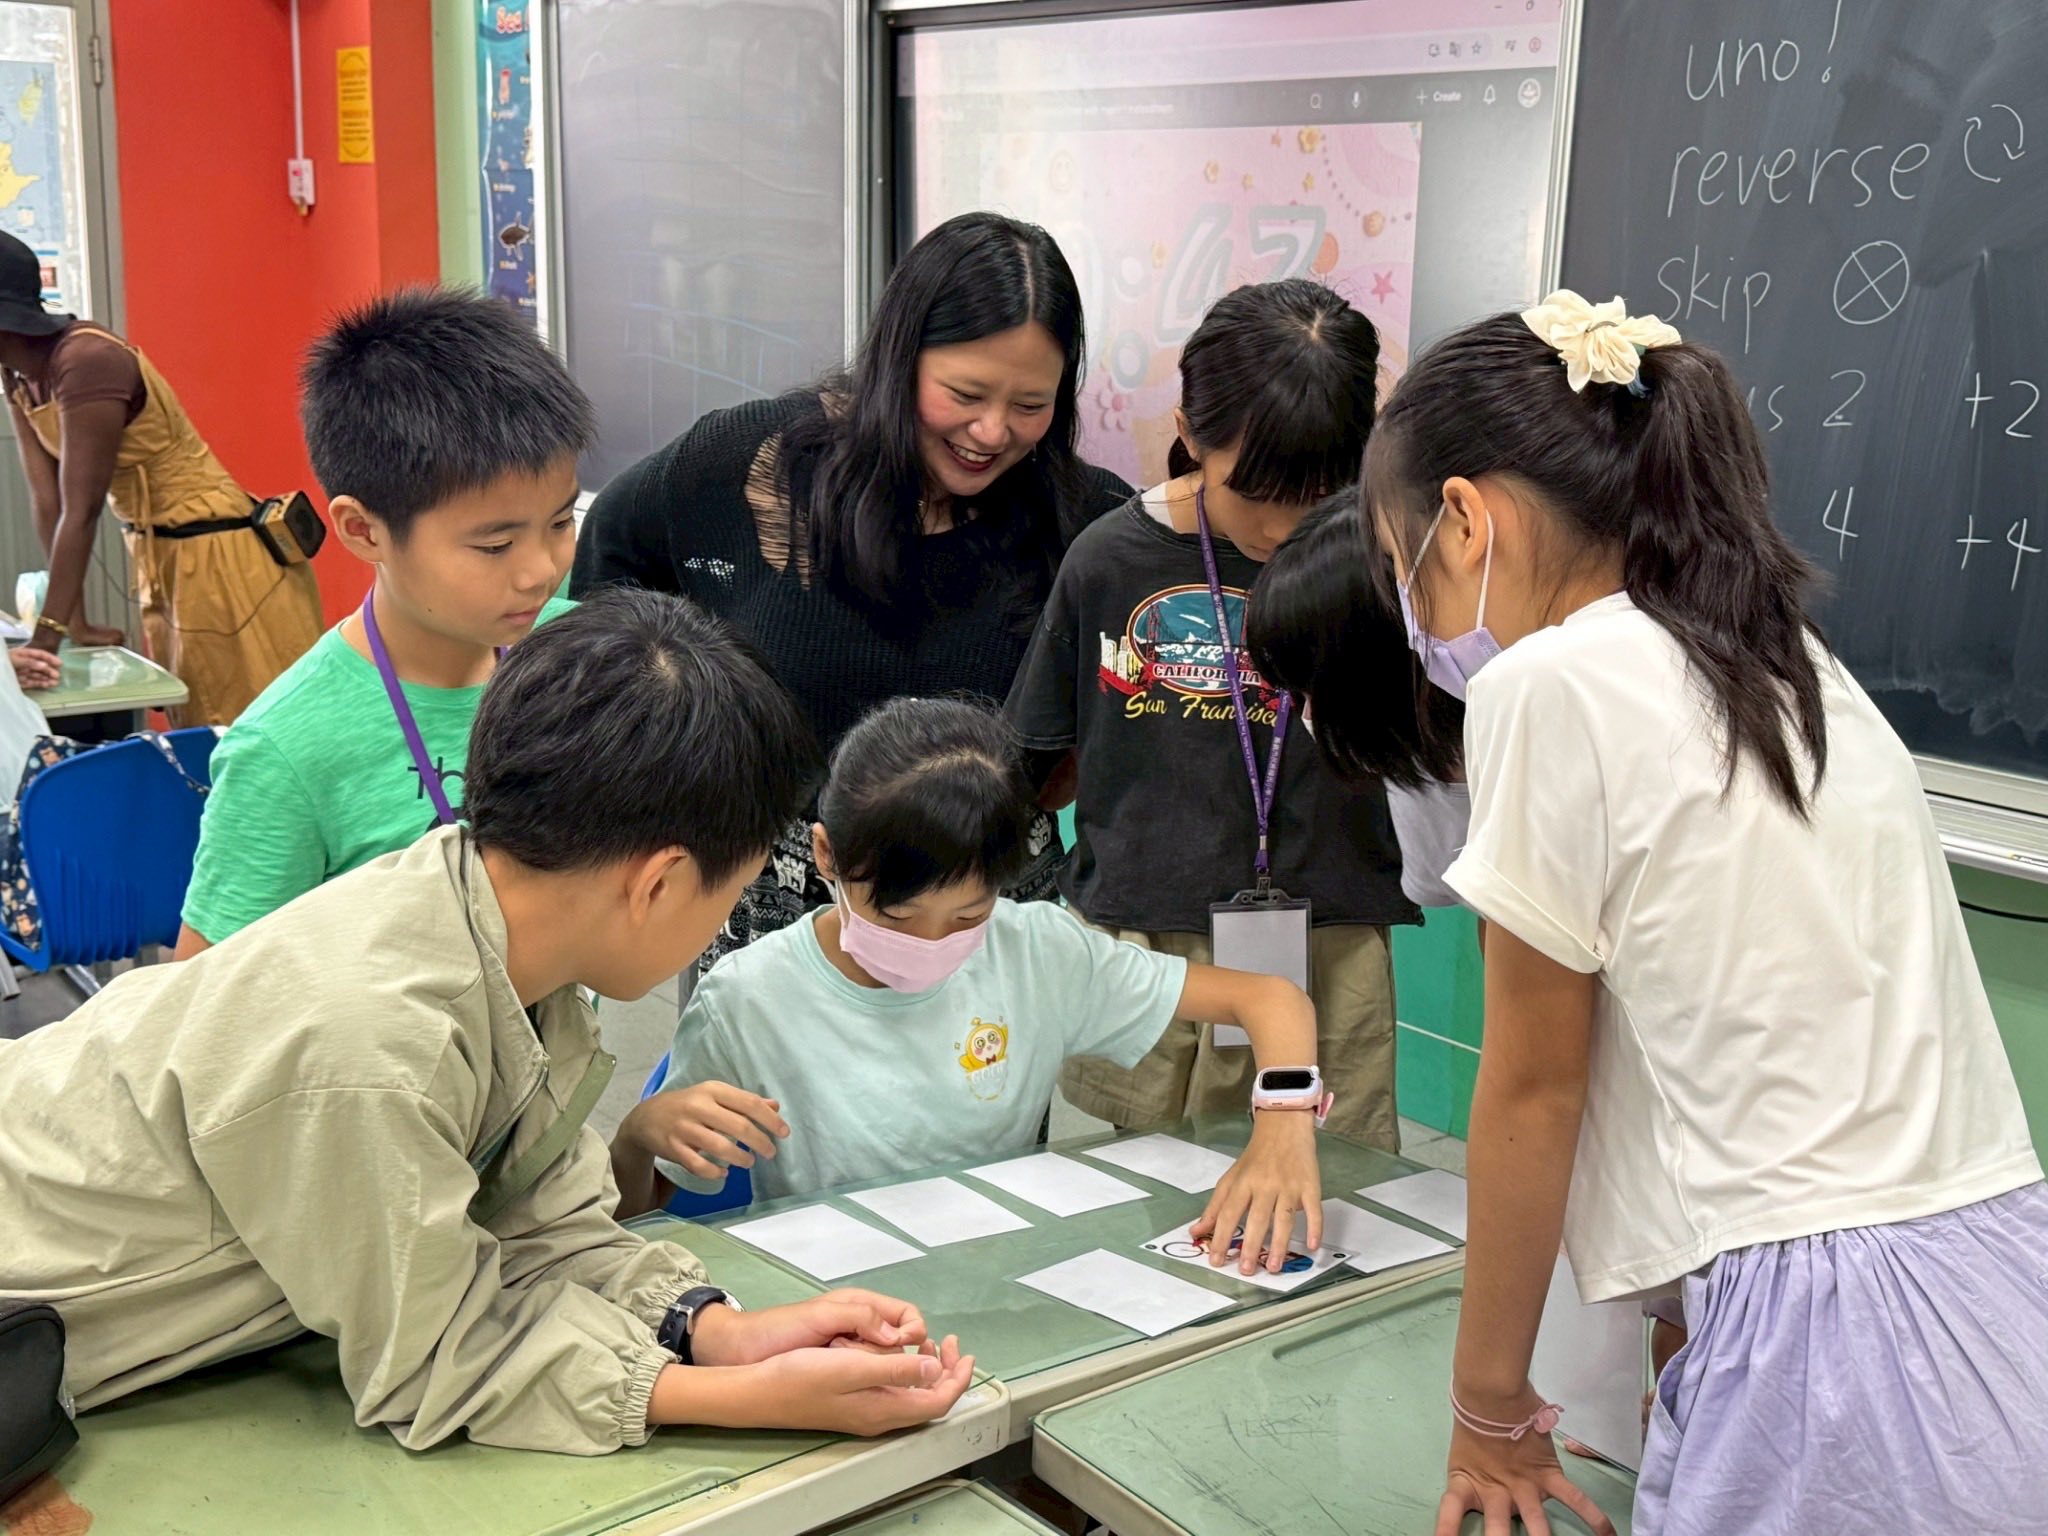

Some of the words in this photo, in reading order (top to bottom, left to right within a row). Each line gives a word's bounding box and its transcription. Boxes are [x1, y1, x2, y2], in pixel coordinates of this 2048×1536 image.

[1667, 143, 1930, 217] reverse
[1657, 245, 1770, 354] skip
[1823, 369, 1866, 427] 2
[1822, 487, 1859, 562] 4
[1153, 664, 1261, 685] CALIFORIA
[1124, 691, 1167, 719] San
[1179, 695, 1277, 727] Franisc
